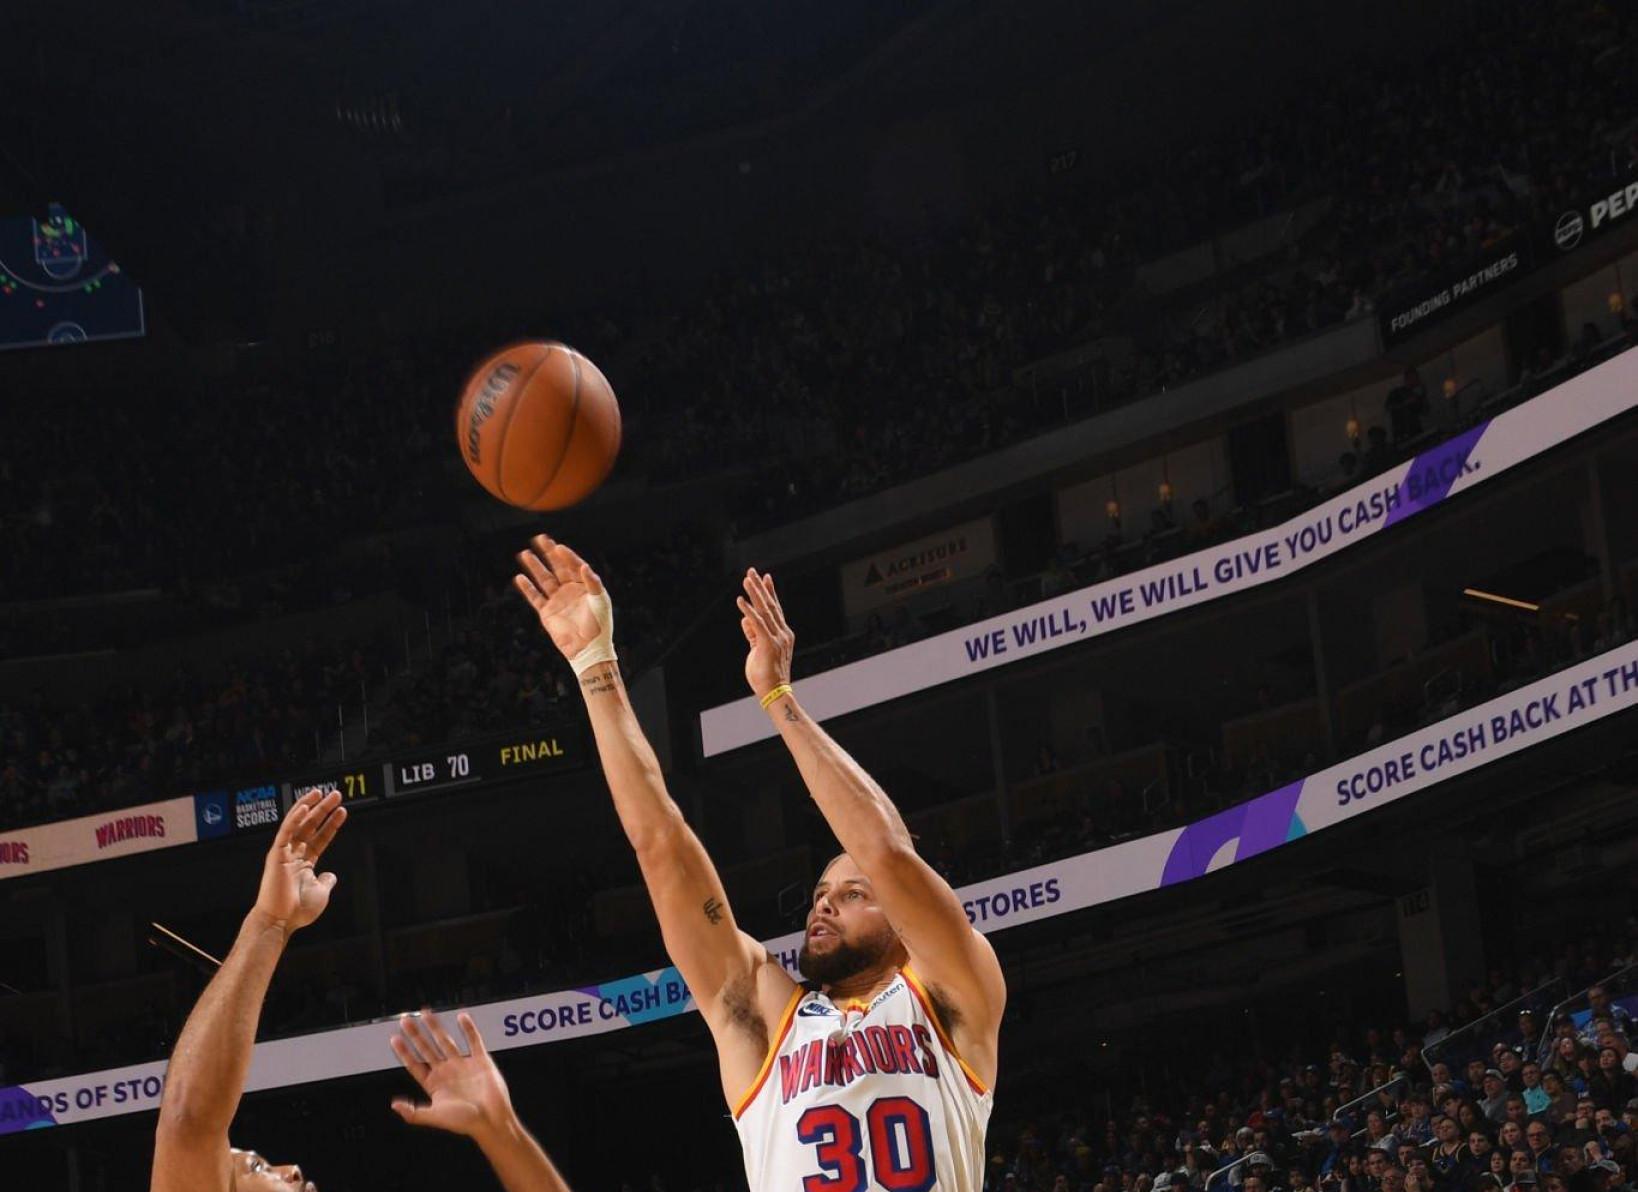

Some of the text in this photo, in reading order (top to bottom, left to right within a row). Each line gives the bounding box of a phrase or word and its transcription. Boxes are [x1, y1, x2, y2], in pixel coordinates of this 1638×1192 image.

[1391, 251, 1519, 333] FOUNDING PARTNERS
[966, 457, 1482, 662] WE WILL, WE WILL GIVE YOU CASH BACK.
[1337, 660, 1638, 806] SCORE CASH BACK AT TH
[402, 754, 469, 784] LIB 70
[501, 739, 563, 765] FINAL
[345, 774, 366, 797] 71
[95, 815, 165, 849] WARRIORS
[236, 809, 279, 828] SCORES
[504, 1002, 593, 1037] SCORE
[599, 985, 660, 1020] CASH
[962, 878, 1061, 924] STORES
[805, 1002, 830, 1015] NIKE
[779, 1024, 940, 1104] WARRIORS
[76, 1085, 108, 1110] OF
[113, 1075, 166, 1103] STO
